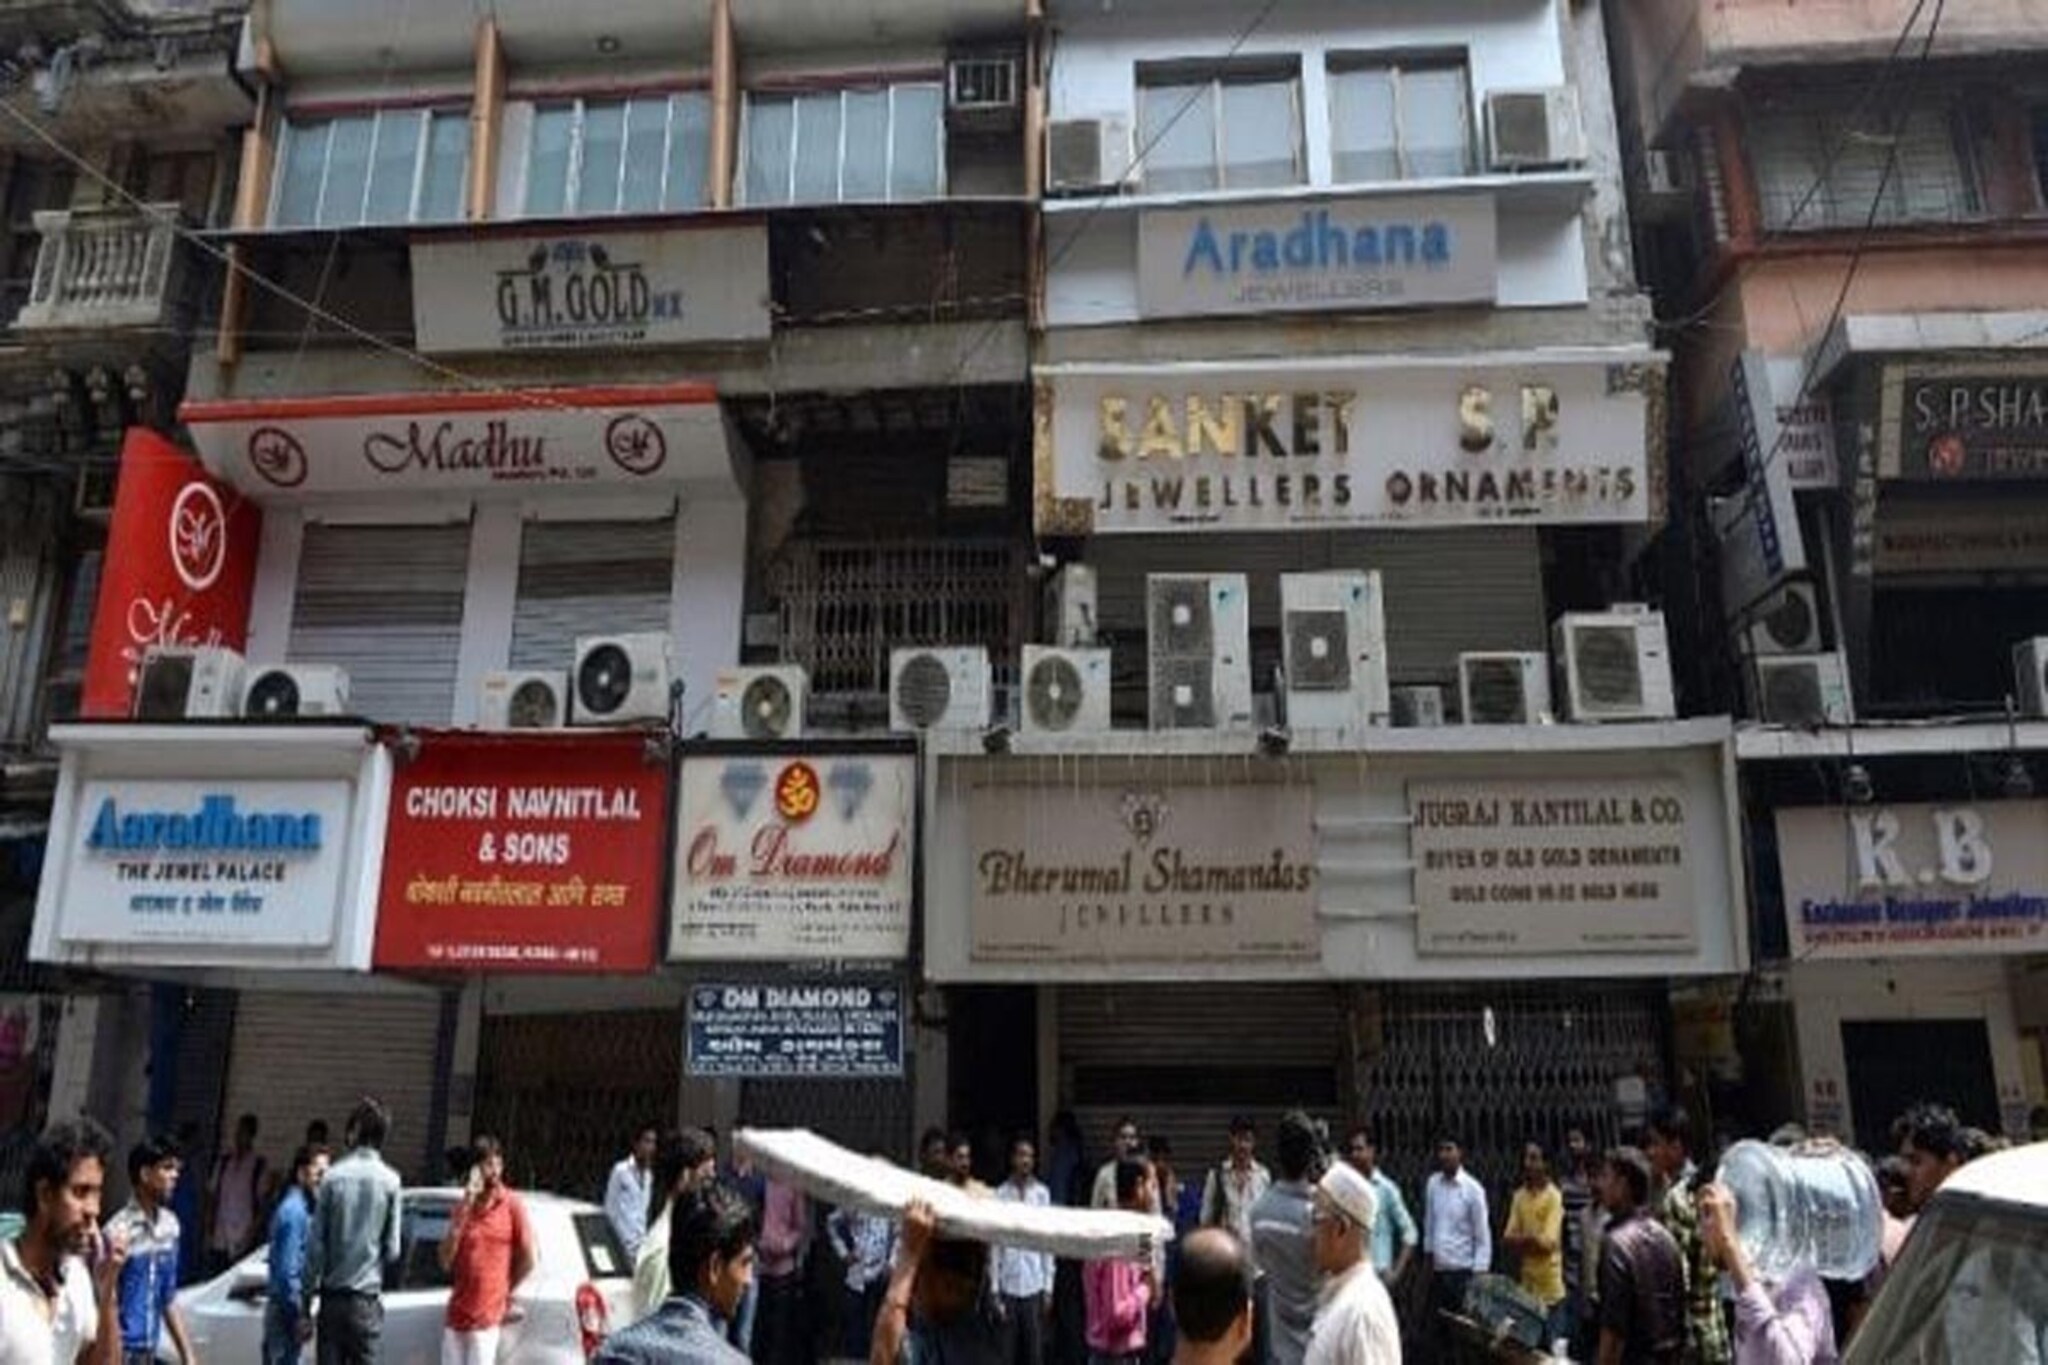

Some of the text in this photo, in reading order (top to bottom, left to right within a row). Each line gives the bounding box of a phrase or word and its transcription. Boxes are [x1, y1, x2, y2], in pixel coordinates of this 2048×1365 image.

[1184, 209, 1450, 275] Aradhana
[1234, 277, 1404, 302] JEWELLERS
[364, 421, 544, 473] Madhu
[1097, 391, 1356, 461] SANKET
[1099, 466, 1636, 510] JEWELLERS ORNAMENTS
[406, 786, 642, 820] CHOKSI NAVNITLAL
[1414, 799, 1499, 827] JUGRAJ
[1511, 799, 1623, 827] KANTILAL
[1630, 801, 1646, 823] &
[479, 832, 569, 864] & SONS
[687, 824, 899, 878] Om Diamond
[1852, 809, 1993, 888] K.B
[117, 863, 286, 882] THE JEWEL PALACE
[979, 848, 1313, 896] Bherumal Shamandas
[722, 987, 872, 1009] OM DIAMOND
